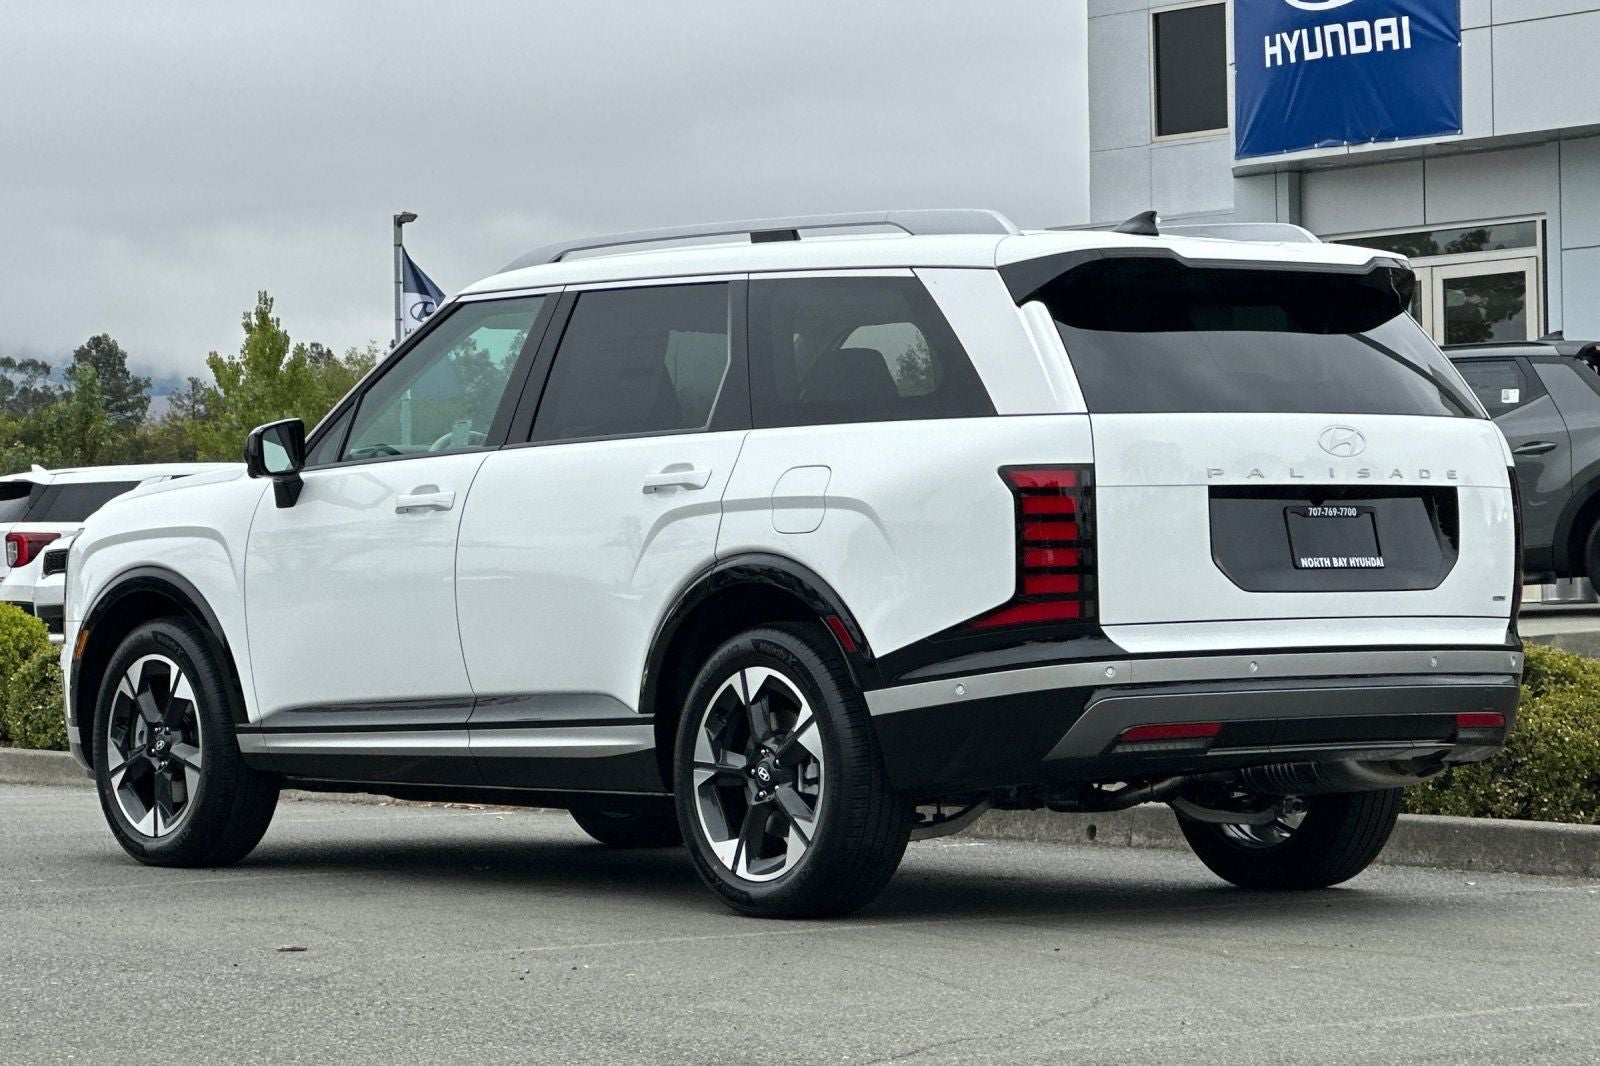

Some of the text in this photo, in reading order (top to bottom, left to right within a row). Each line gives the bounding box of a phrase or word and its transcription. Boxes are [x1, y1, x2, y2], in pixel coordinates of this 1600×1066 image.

[1264, 16, 1412, 68] HYUNDAI
[1206, 467, 1459, 480] PALISADE
[1308, 507, 1357, 517] 707-769-7700
[1300, 557, 1385, 568] NORTH BAY HYUNDAI
